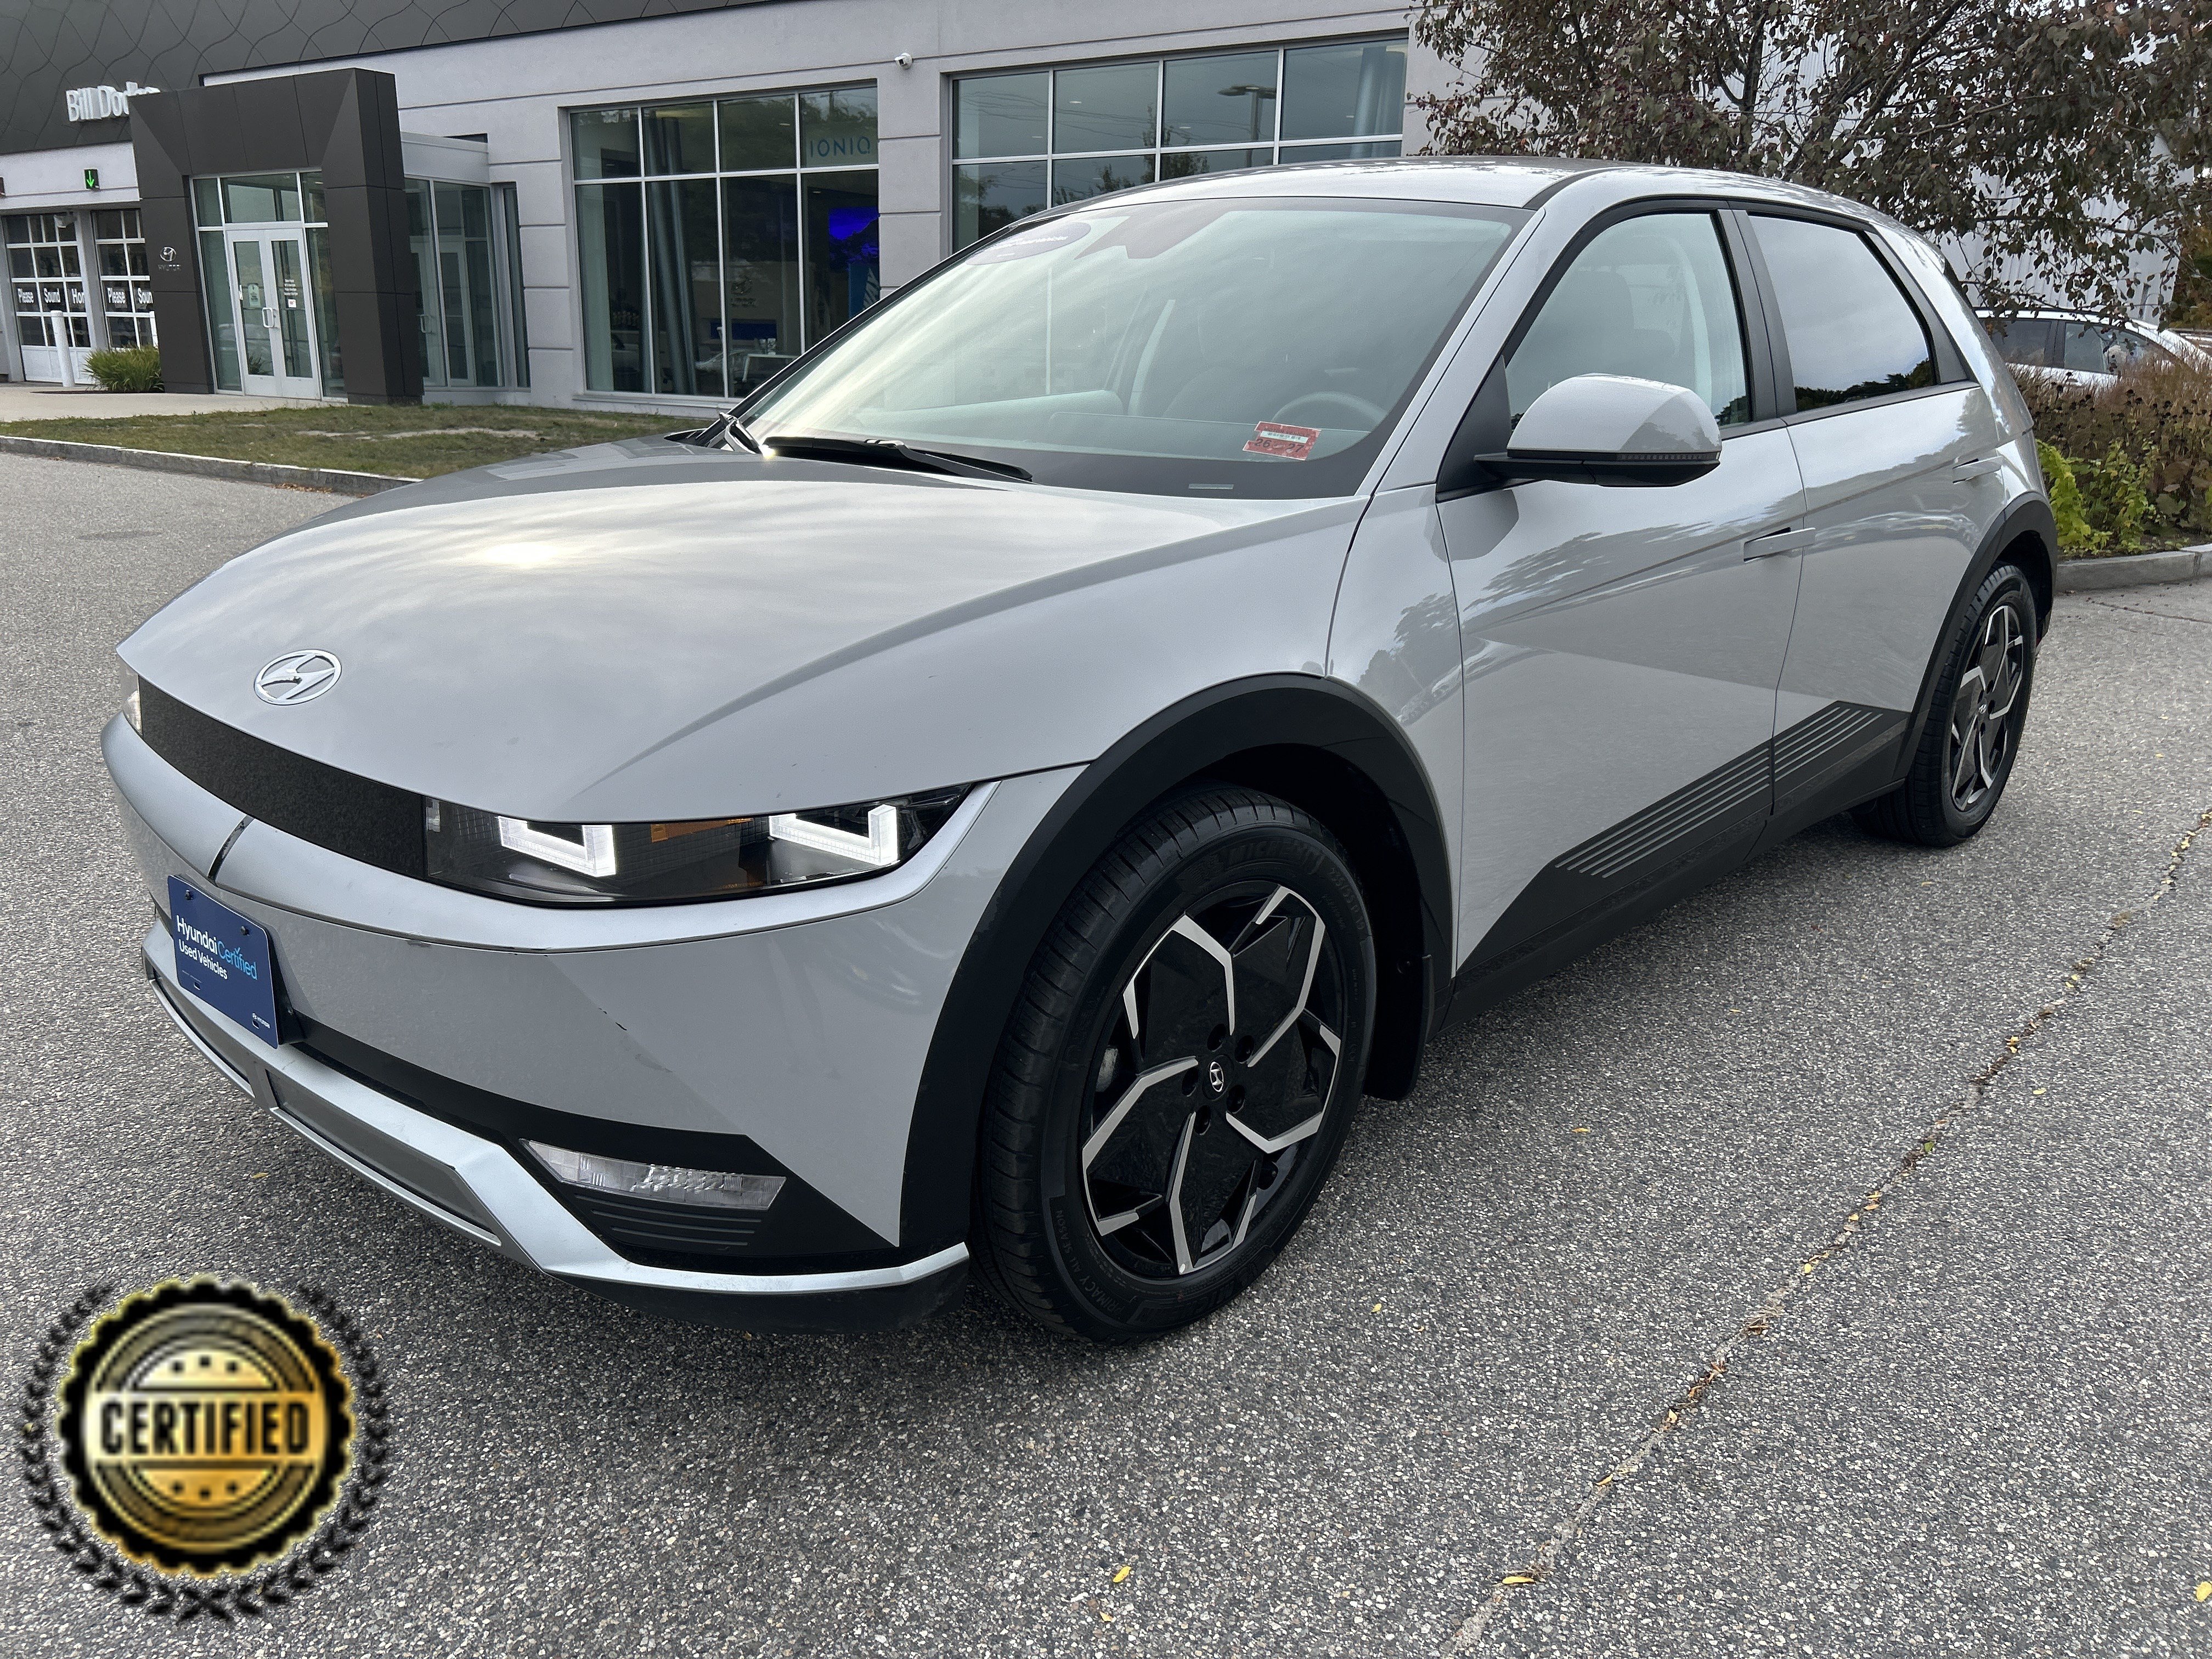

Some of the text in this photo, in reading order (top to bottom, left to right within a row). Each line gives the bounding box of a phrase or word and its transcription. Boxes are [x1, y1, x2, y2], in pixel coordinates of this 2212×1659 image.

[66, 87, 95, 121] Bill
[810, 136, 871, 158] IONIQ
[17, 287, 34, 303] Please
[43, 287, 61, 303] Sound
[107, 287, 154, 304] Please Soun
[1254, 438, 1272, 448] 26
[176, 915, 258, 980] Hyundai Certified
[178, 939, 198, 961] Used
[198, 950, 228, 980] Vehicles
